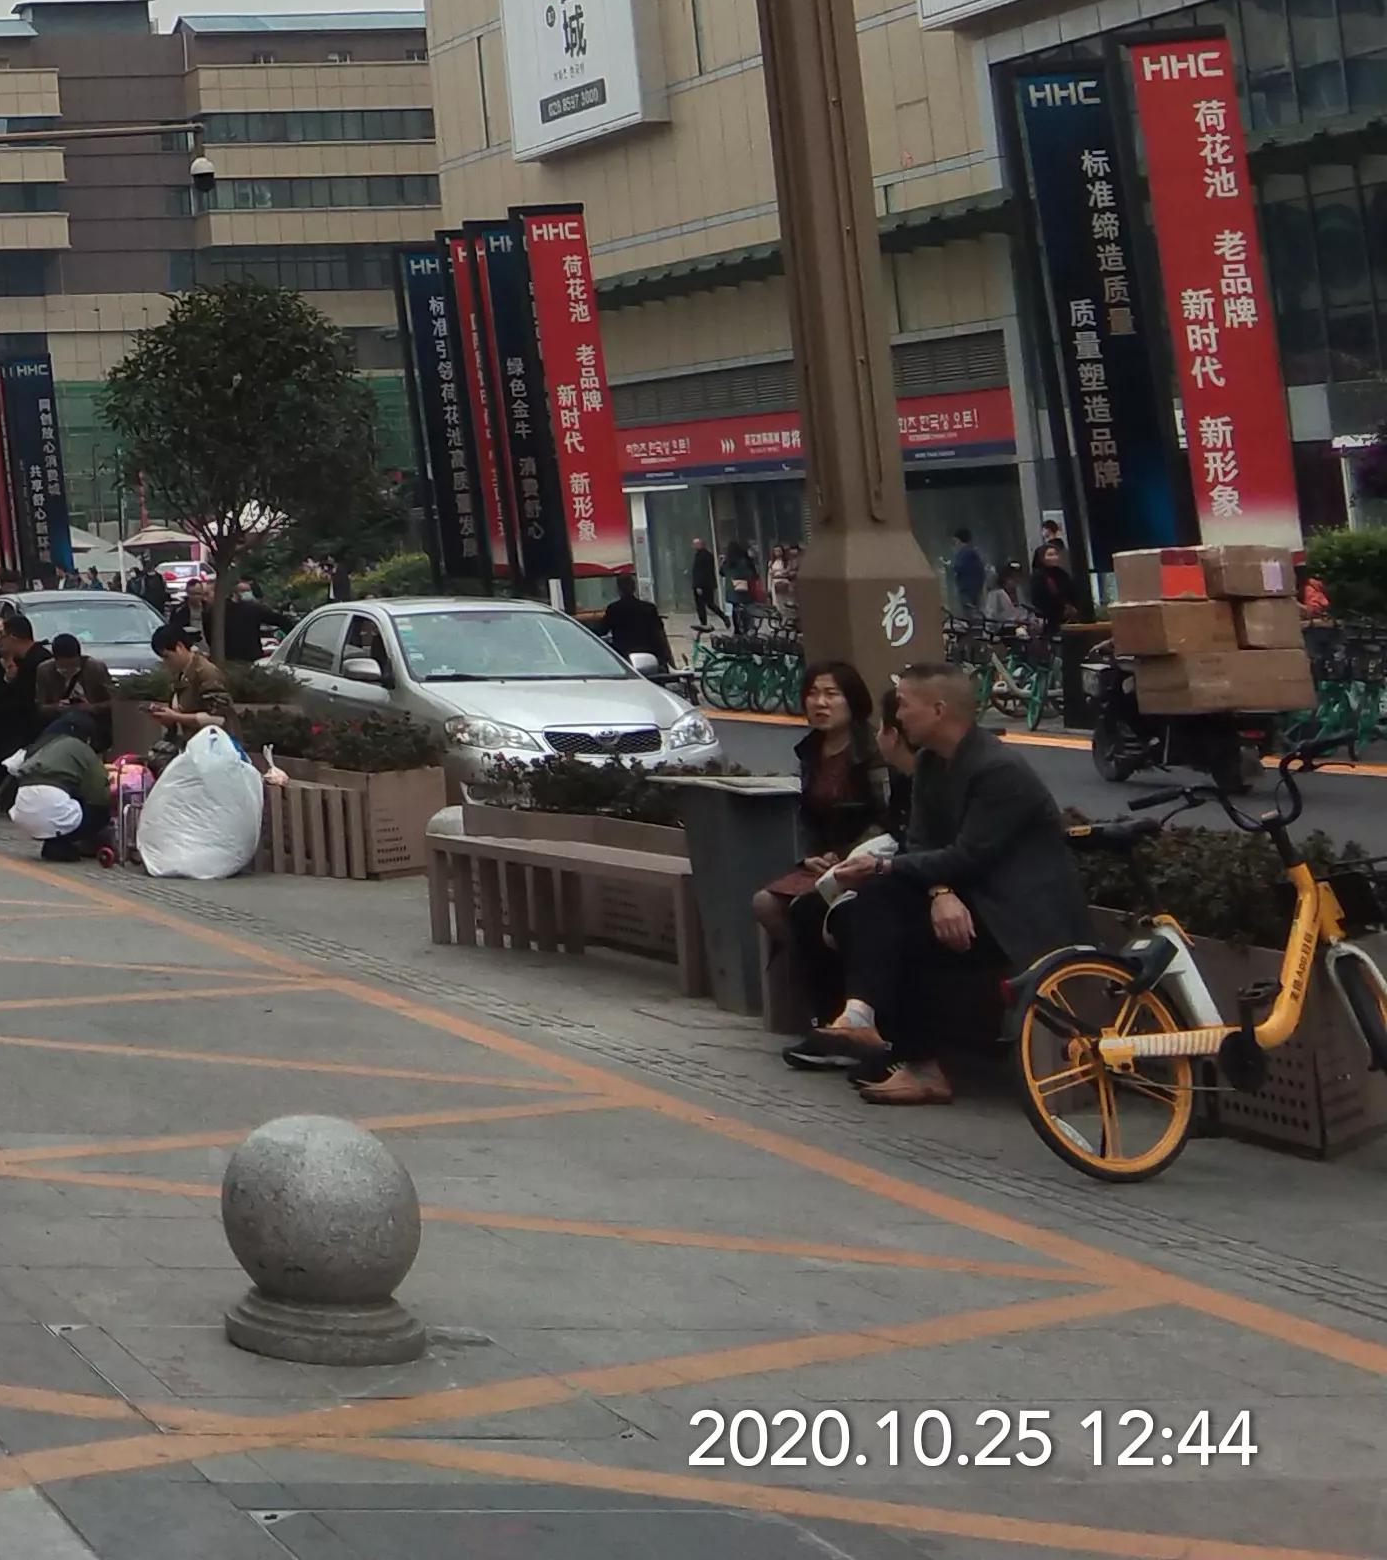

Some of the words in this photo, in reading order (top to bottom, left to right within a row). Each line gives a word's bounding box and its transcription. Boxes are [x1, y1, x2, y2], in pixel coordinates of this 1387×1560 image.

[1028, 80, 1101, 108] HHC
[1142, 51, 1224, 81] HHC
[1192, 99, 1239, 200] 荷花池
[531, 222, 581, 241] HHC
[1080, 148, 1137, 336] 标准缔造质量
[562, 254, 592, 323] 荷花池
[1213, 229, 1259, 329] 老品牌
[1180, 287, 1226, 389] 新时代
[506, 357, 533, 439] 绿色金牛
[575, 343, 604, 412] 老品牌
[1069, 298, 1123, 489] 质量塑造品牌
[556, 384, 586, 454] 新时代
[1198, 415, 1243, 518] 新形象
[568, 472, 598, 541] 新形象
